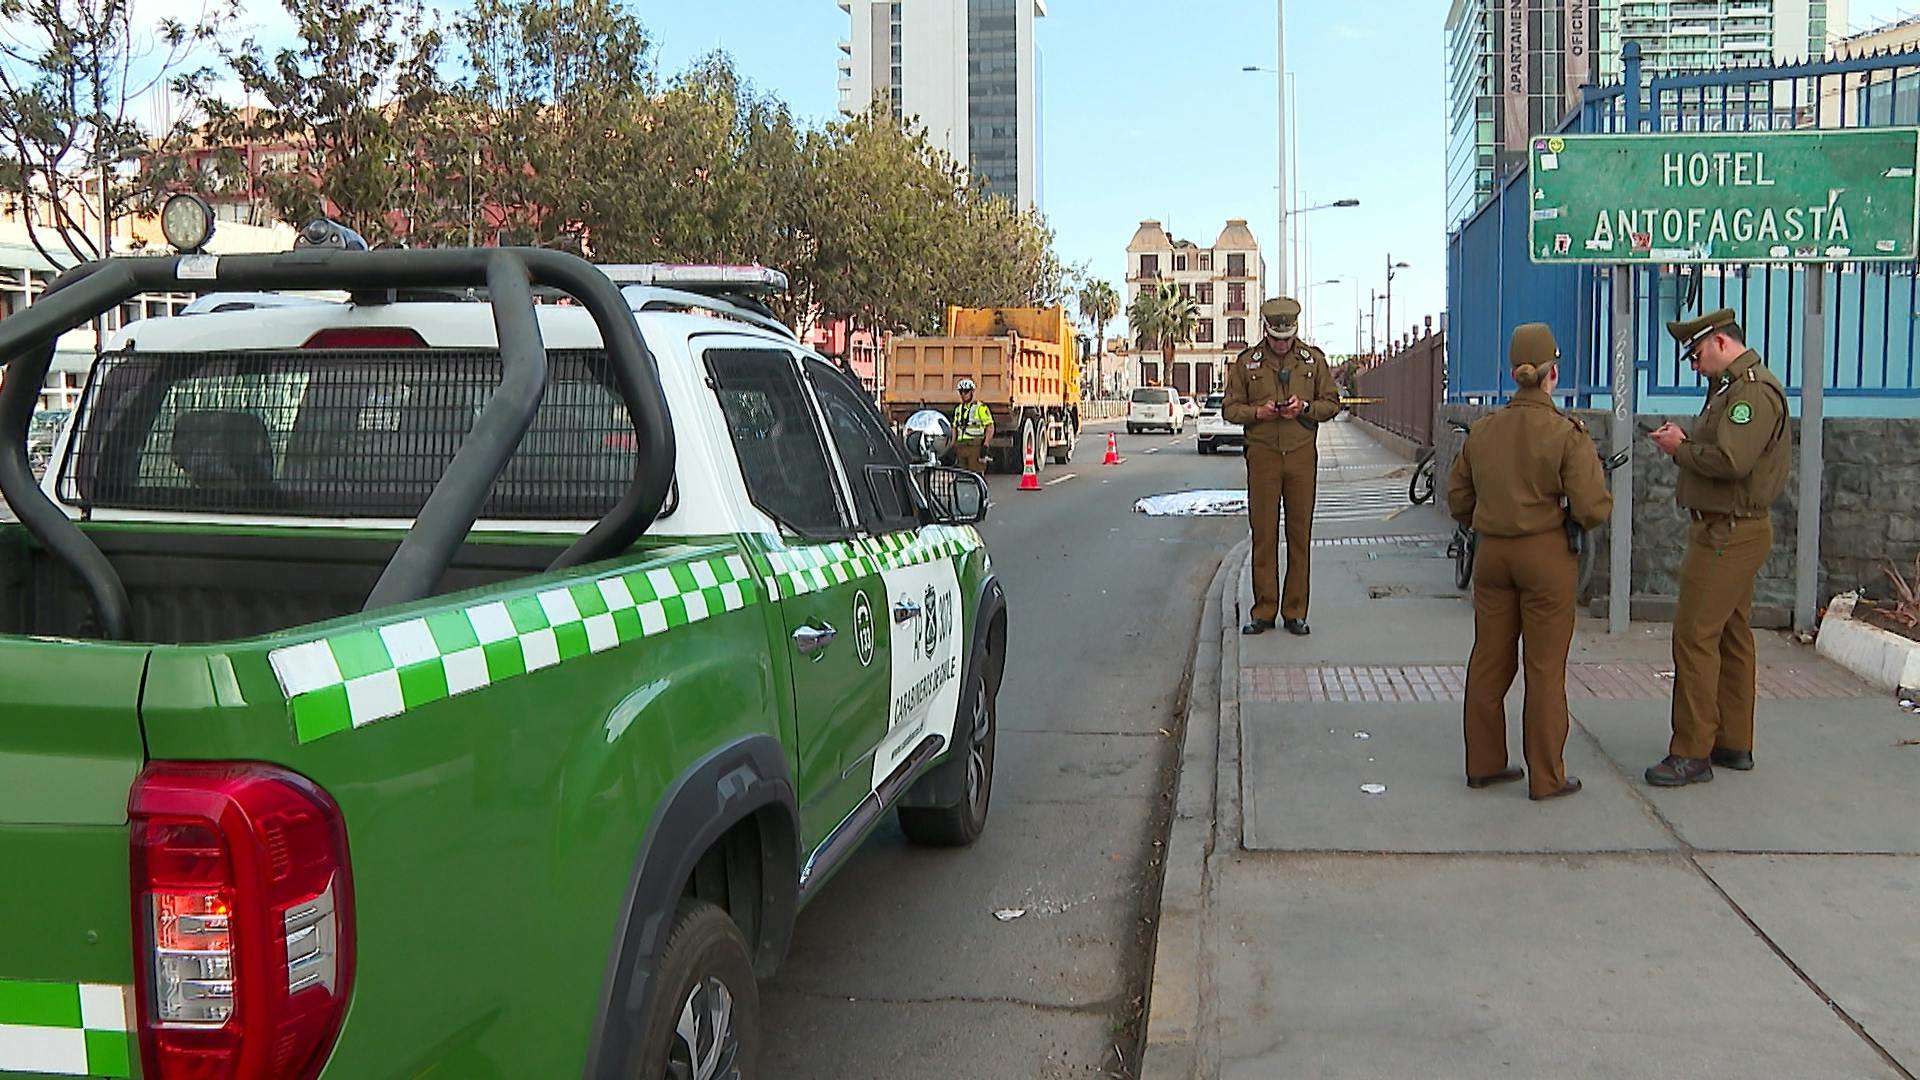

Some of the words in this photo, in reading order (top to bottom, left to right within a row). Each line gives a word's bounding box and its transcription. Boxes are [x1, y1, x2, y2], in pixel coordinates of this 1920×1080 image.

[1572, 0, 1583, 56] OFICIN
[1663, 151, 1775, 187] HOTEL
[1593, 206, 1849, 243] ANTOFAGASTA
[860, 626, 871, 654] 133
[895, 672, 933, 724] CARABINEROS
[939, 655, 956, 686] CHILE
